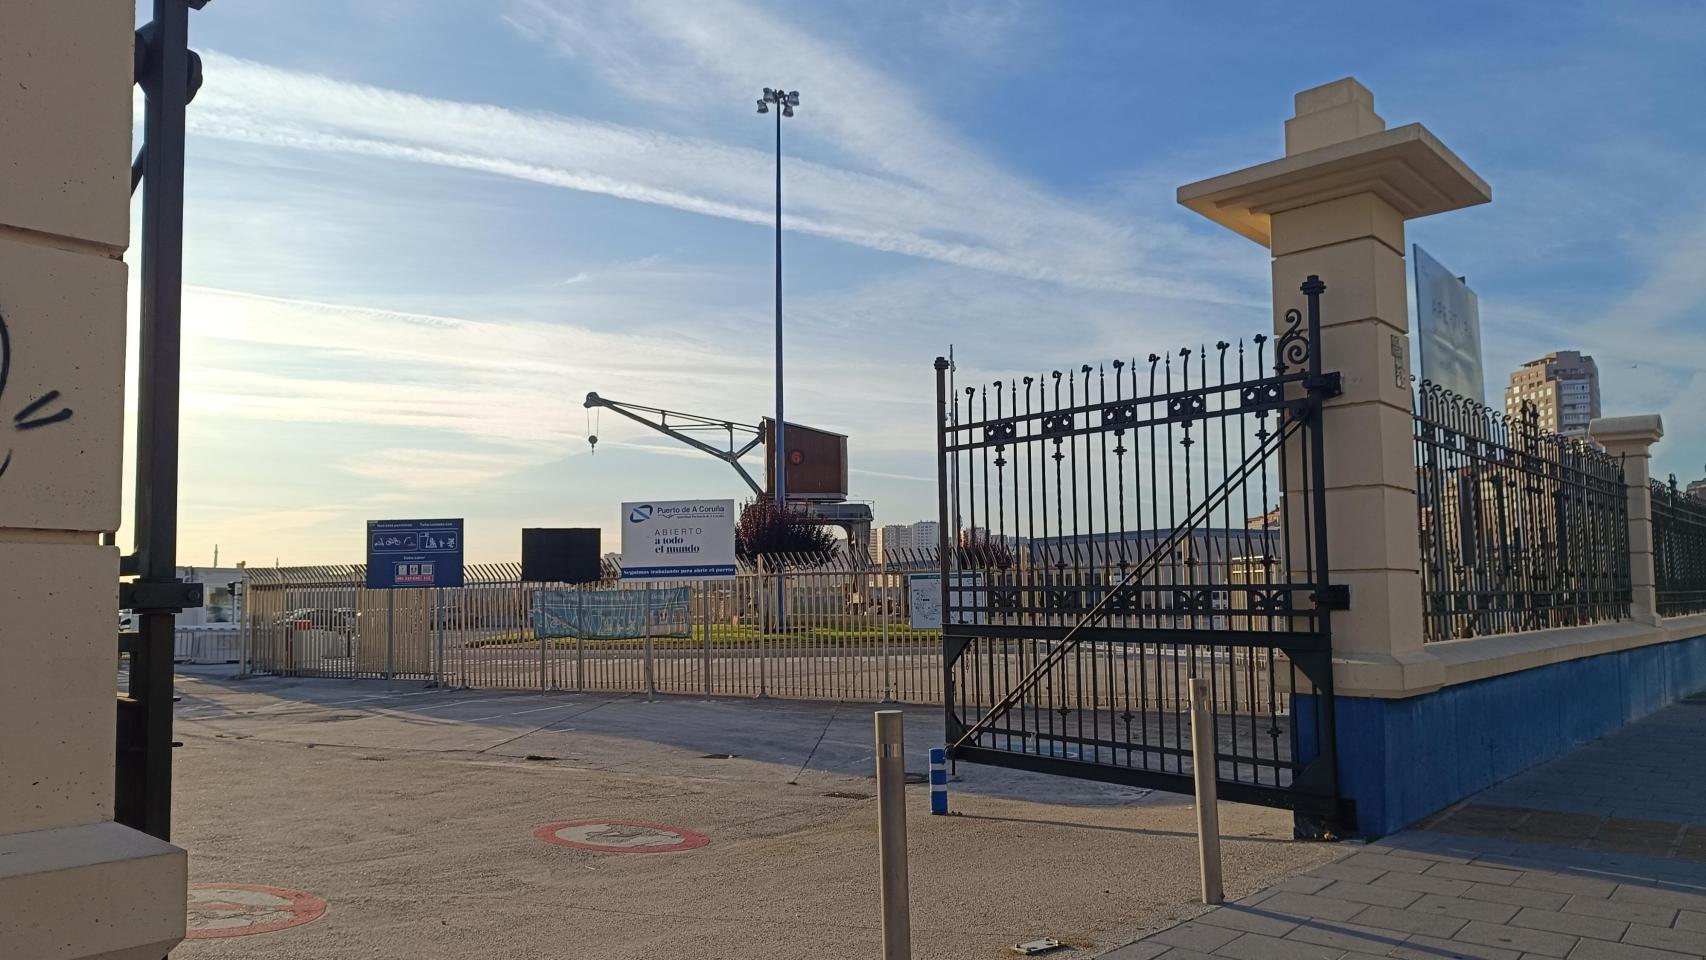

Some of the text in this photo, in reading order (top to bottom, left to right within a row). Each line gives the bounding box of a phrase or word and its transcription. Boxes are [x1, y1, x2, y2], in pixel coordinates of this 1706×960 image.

[791, 451, 801, 463] 6
[655, 527, 702, 536] ABIERTO
[662, 536, 683, 544] todo
[655, 544, 700, 554] el mundo
